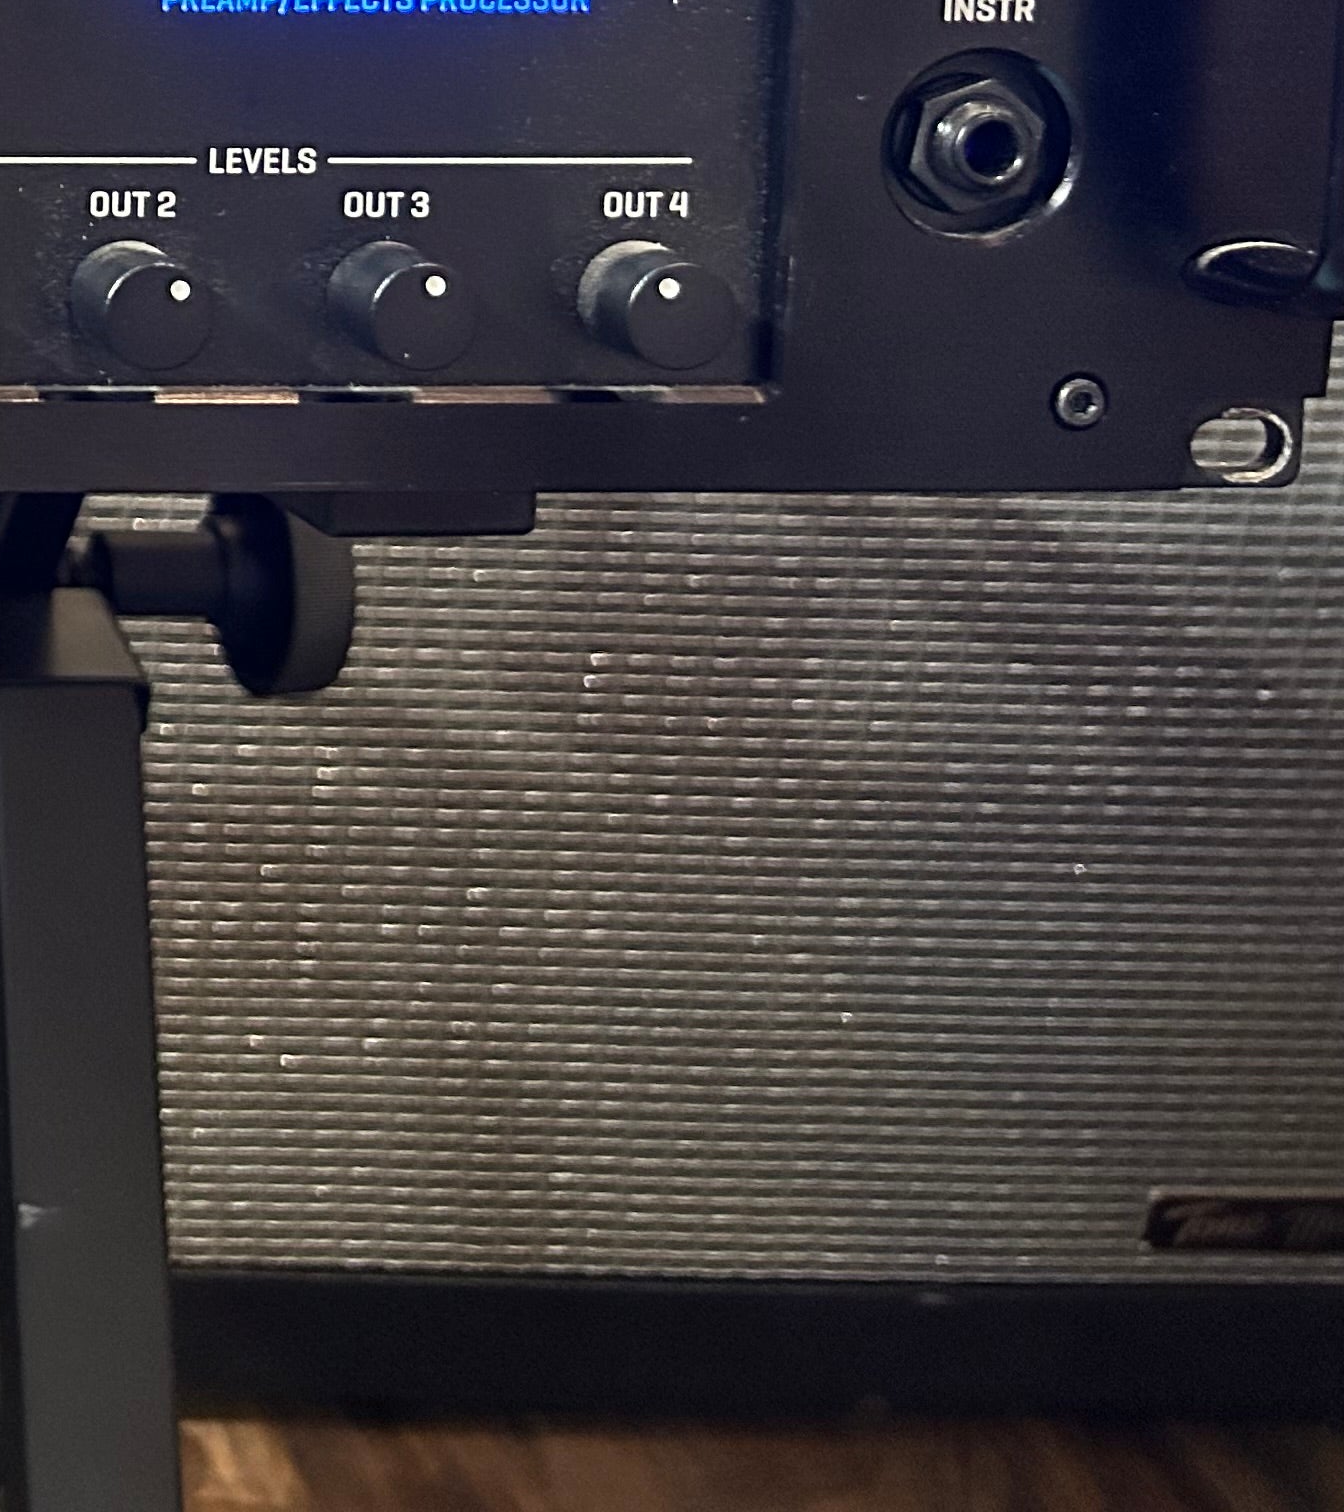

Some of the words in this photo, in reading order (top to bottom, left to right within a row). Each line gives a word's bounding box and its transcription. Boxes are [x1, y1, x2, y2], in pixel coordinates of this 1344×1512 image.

[209, 147, 317, 175] LEVELS
[89, 189, 152, 218] OUT
[157, 189, 177, 218] 2
[343, 190, 406, 218] OUT
[410, 190, 431, 218] 3
[603, 190, 665, 219] OUT
[668, 190, 689, 219] 4
